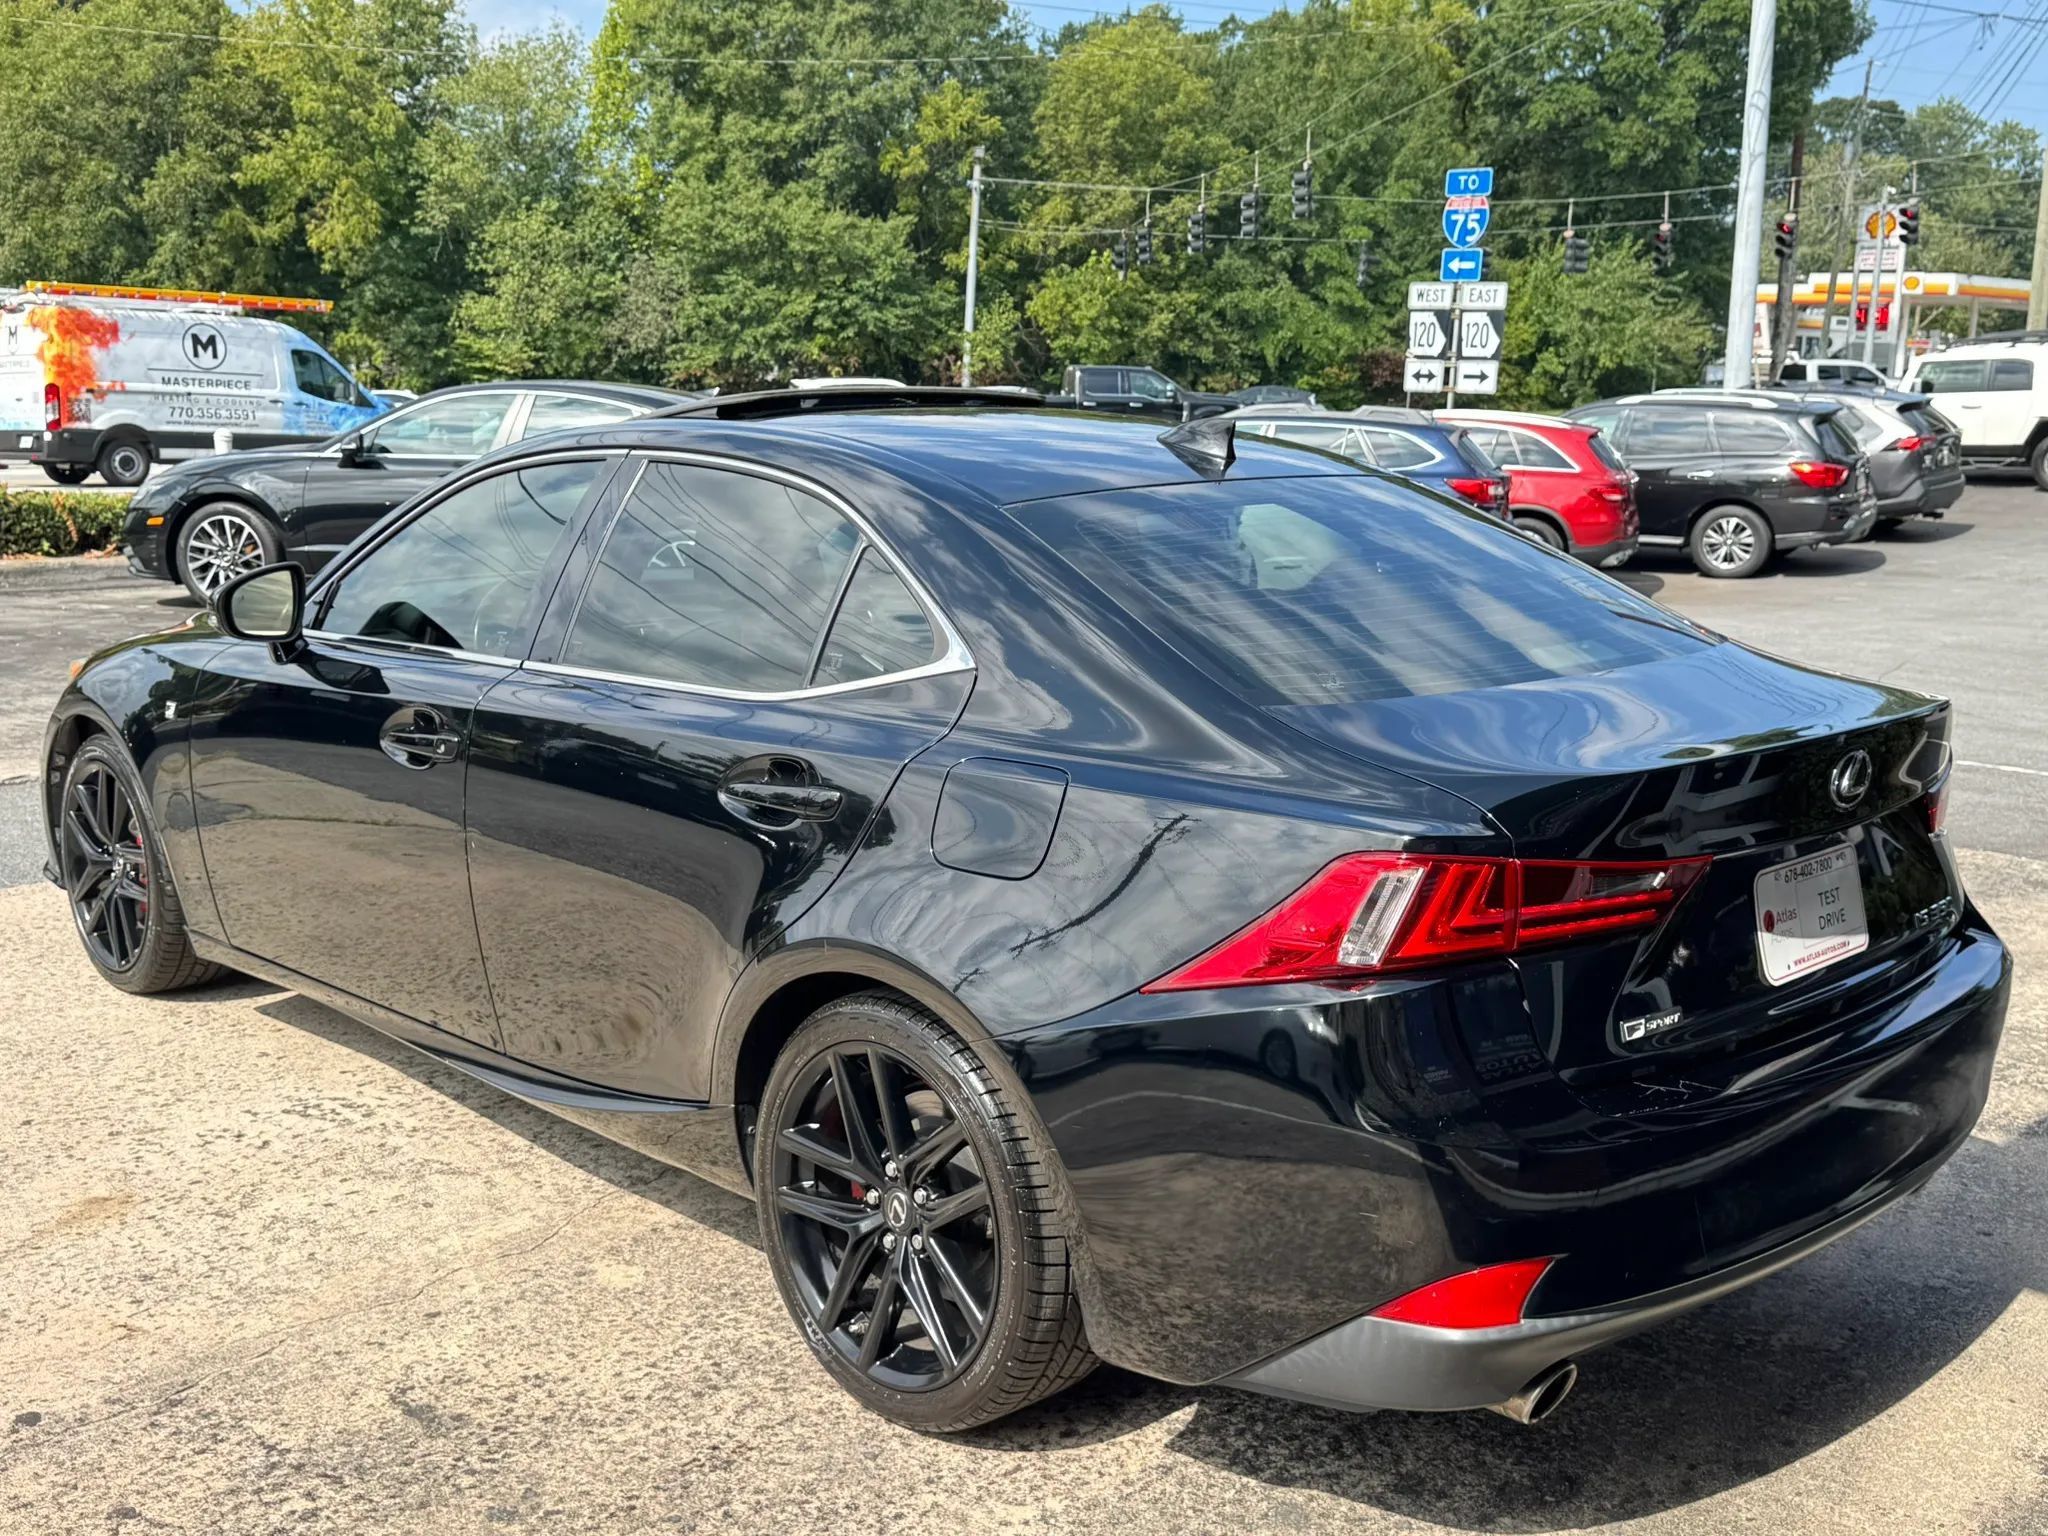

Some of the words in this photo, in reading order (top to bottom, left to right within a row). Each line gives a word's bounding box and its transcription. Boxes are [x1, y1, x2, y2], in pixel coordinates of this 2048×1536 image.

[1458, 174, 1480, 191] TO
[1451, 213, 1480, 242] 75
[1416, 287, 1446, 303] WEST
[1469, 287, 1498, 303] EAST
[1413, 321, 1436, 348] 120
[1465, 322, 1490, 349] 120
[190, 332, 219, 360] M
[160, 376, 252, 391] MASTERPIECE
[169, 406, 256, 421] 770.356.3591
[1783, 856, 1833, 884] 678-402-7800
[1817, 886, 1841, 907] TEST
[1776, 908, 1798, 925] Atlas
[1818, 908, 1847, 930] DRIVE
[1646, 1012, 1681, 1031] SPORT
